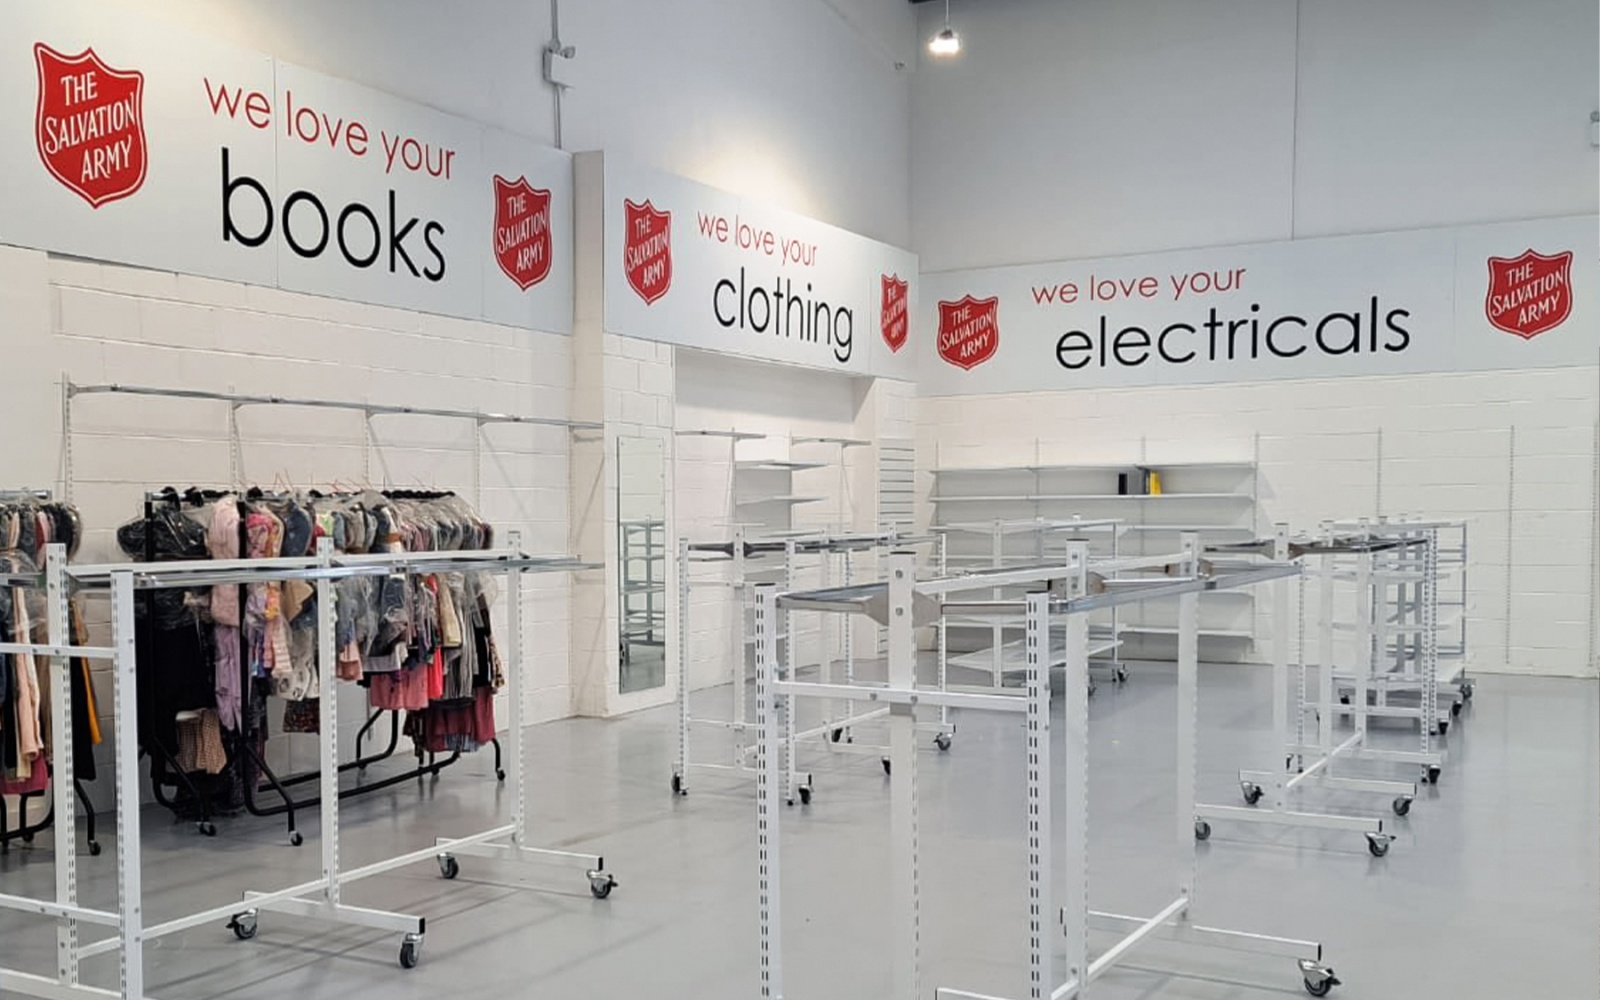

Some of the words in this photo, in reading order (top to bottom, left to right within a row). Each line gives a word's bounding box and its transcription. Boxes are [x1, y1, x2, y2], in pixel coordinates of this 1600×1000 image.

[60, 71, 98, 106] THE
[45, 91, 135, 154] SALVATION
[204, 78, 272, 130] we
[286, 92, 370, 158] love
[380, 129, 456, 182] your
[81, 134, 132, 184] ARMY
[221, 146, 446, 282] books
[506, 192, 527, 219] THE
[635, 213, 651, 239] THE
[498, 204, 547, 254] SALVATION
[697, 209, 729, 242] we
[734, 214, 775, 255] love
[780, 234, 818, 267] your
[516, 236, 544, 274] ARMY
[642, 254, 666, 290] ARMY
[1505, 261, 1534, 287] THE
[1031, 279, 1080, 305] we
[1089, 273, 1159, 302] love
[1171, 266, 1247, 298] your
[1491, 265, 1564, 317] SALVATION
[713, 266, 854, 363] clothing
[941, 307, 992, 351] SALVATION
[951, 304, 972, 327] THE
[1518, 291, 1560, 328] ARMY
[960, 329, 991, 360] ARMY
[1055, 295, 1412, 370] electricals
